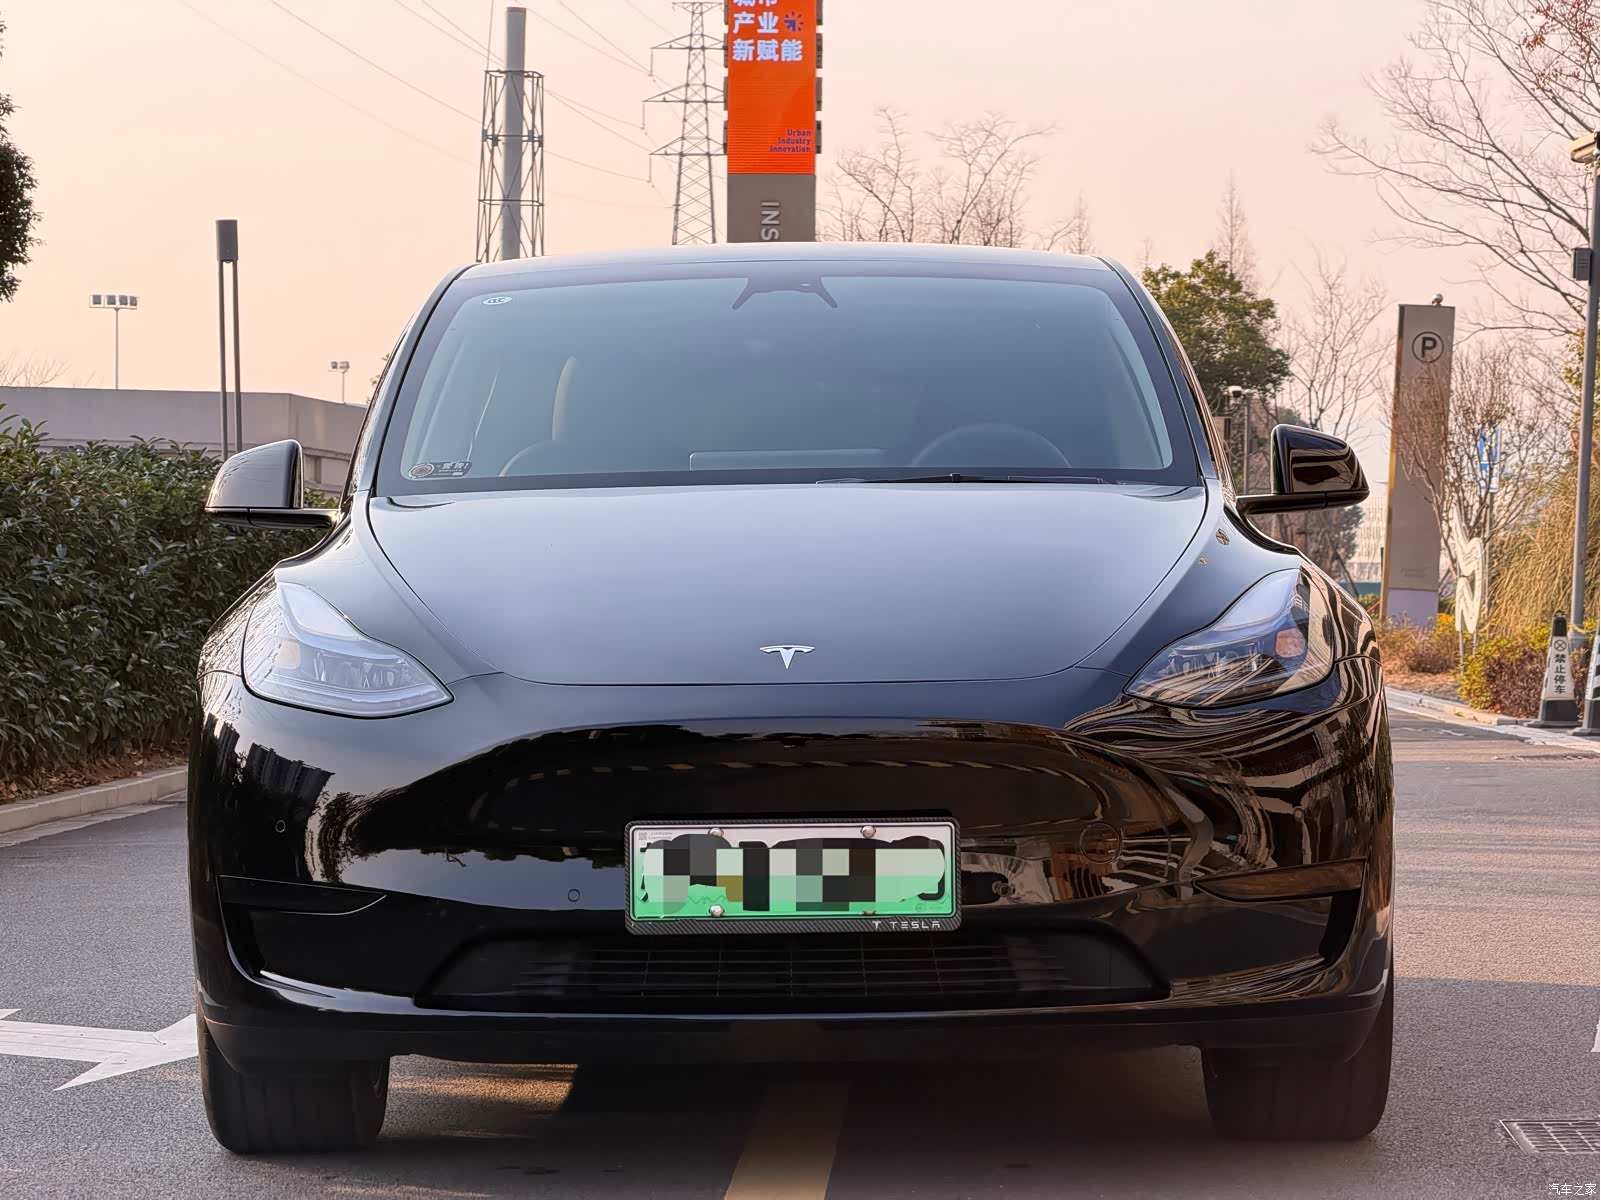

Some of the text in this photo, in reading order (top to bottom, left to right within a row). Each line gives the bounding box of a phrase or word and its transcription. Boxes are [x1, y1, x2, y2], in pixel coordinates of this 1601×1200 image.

[732, 11, 779, 34] 产业
[732, 39, 803, 61] 新赋能
[778, 137, 811, 145] Industry
[1421, 336, 1438, 358] P
[1553, 654, 1567, 694] 禁止停车
[889, 920, 941, 929] TESLA
